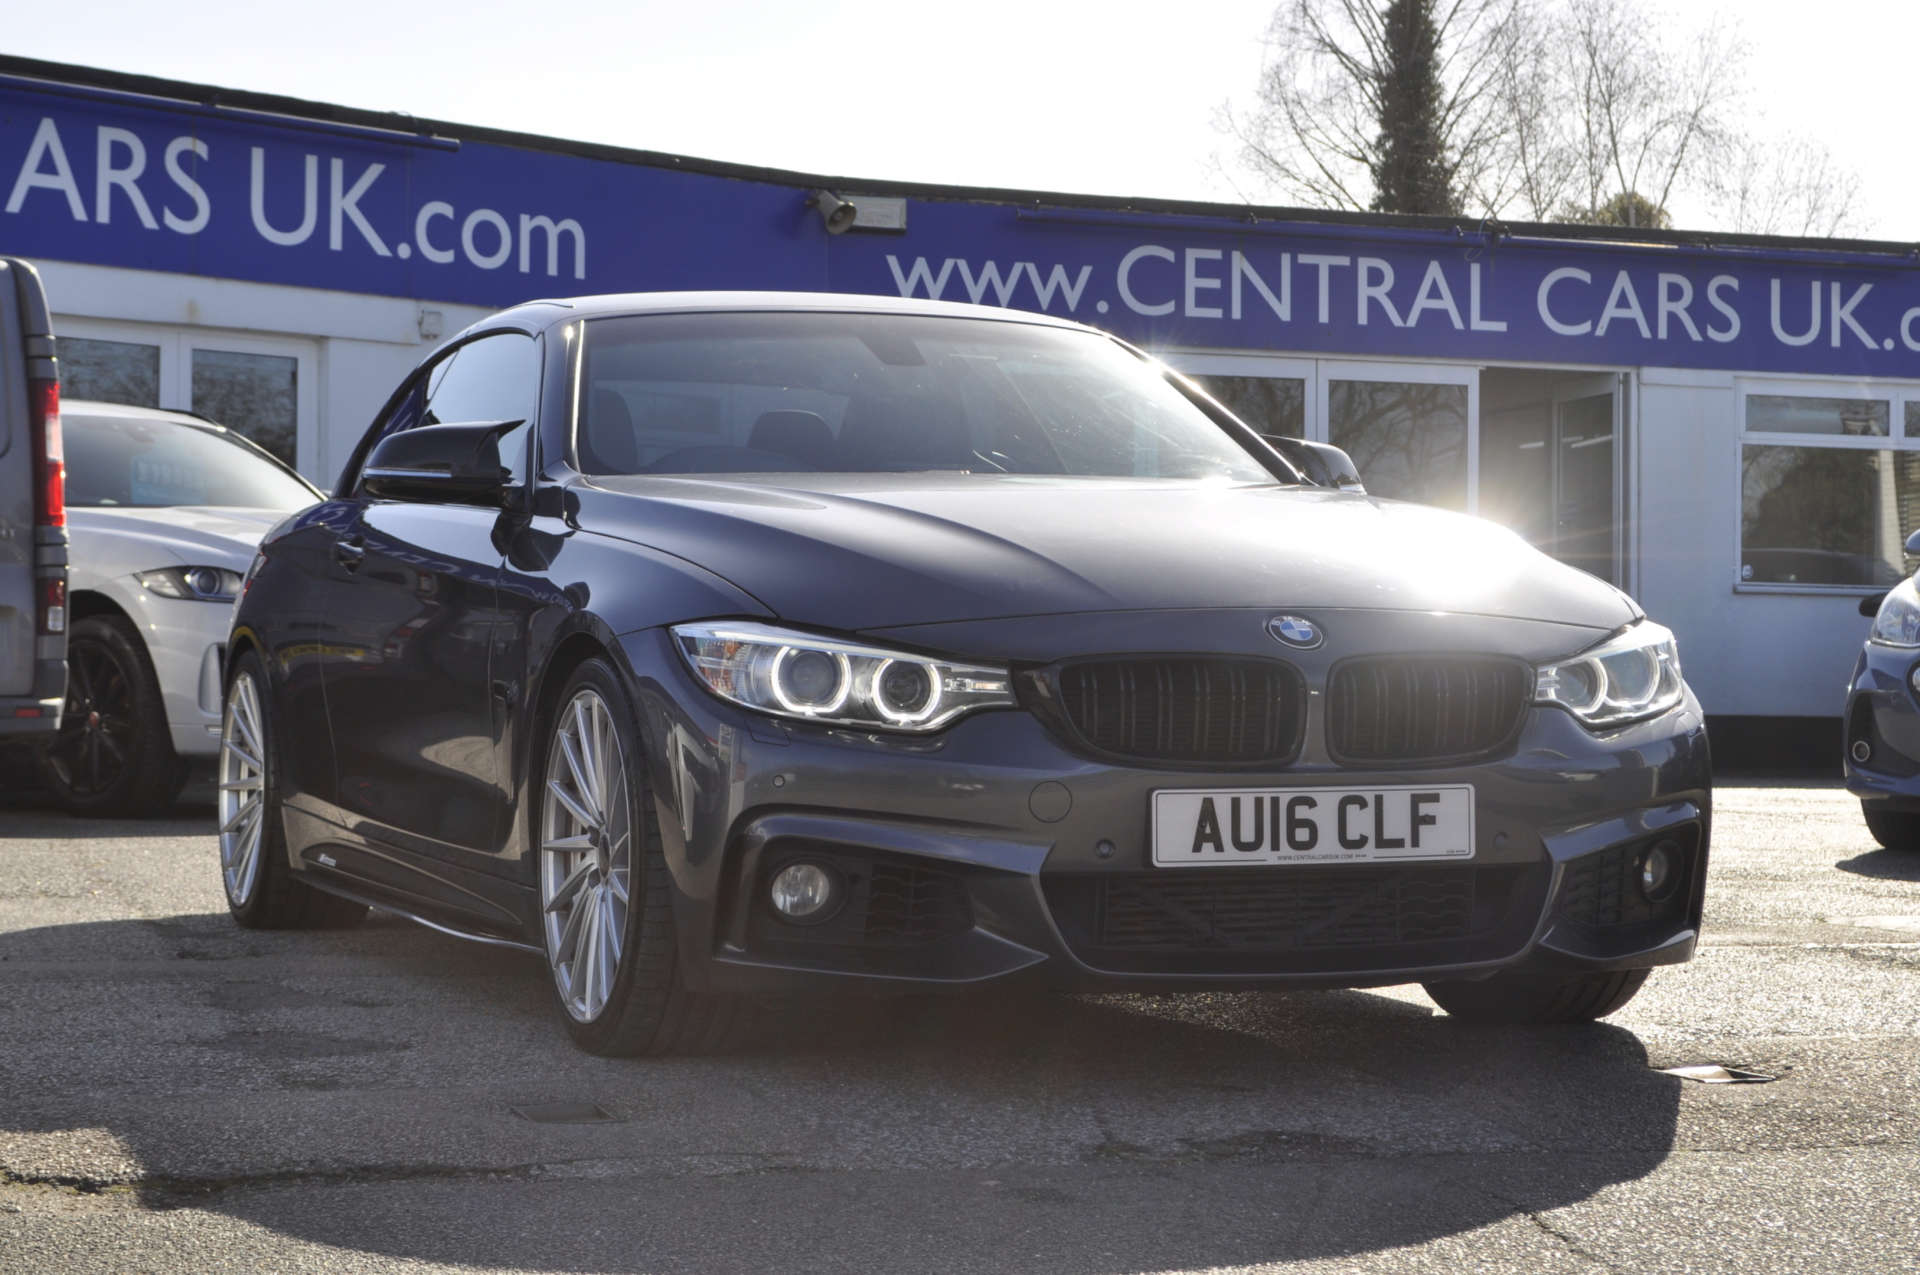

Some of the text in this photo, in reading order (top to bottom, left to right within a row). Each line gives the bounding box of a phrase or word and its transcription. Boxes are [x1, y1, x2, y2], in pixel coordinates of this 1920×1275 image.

[5, 117, 586, 280] ARS UK.com
[1537, 267, 1741, 343] CARS
[1191, 793, 1441, 853] AU16 CLF
